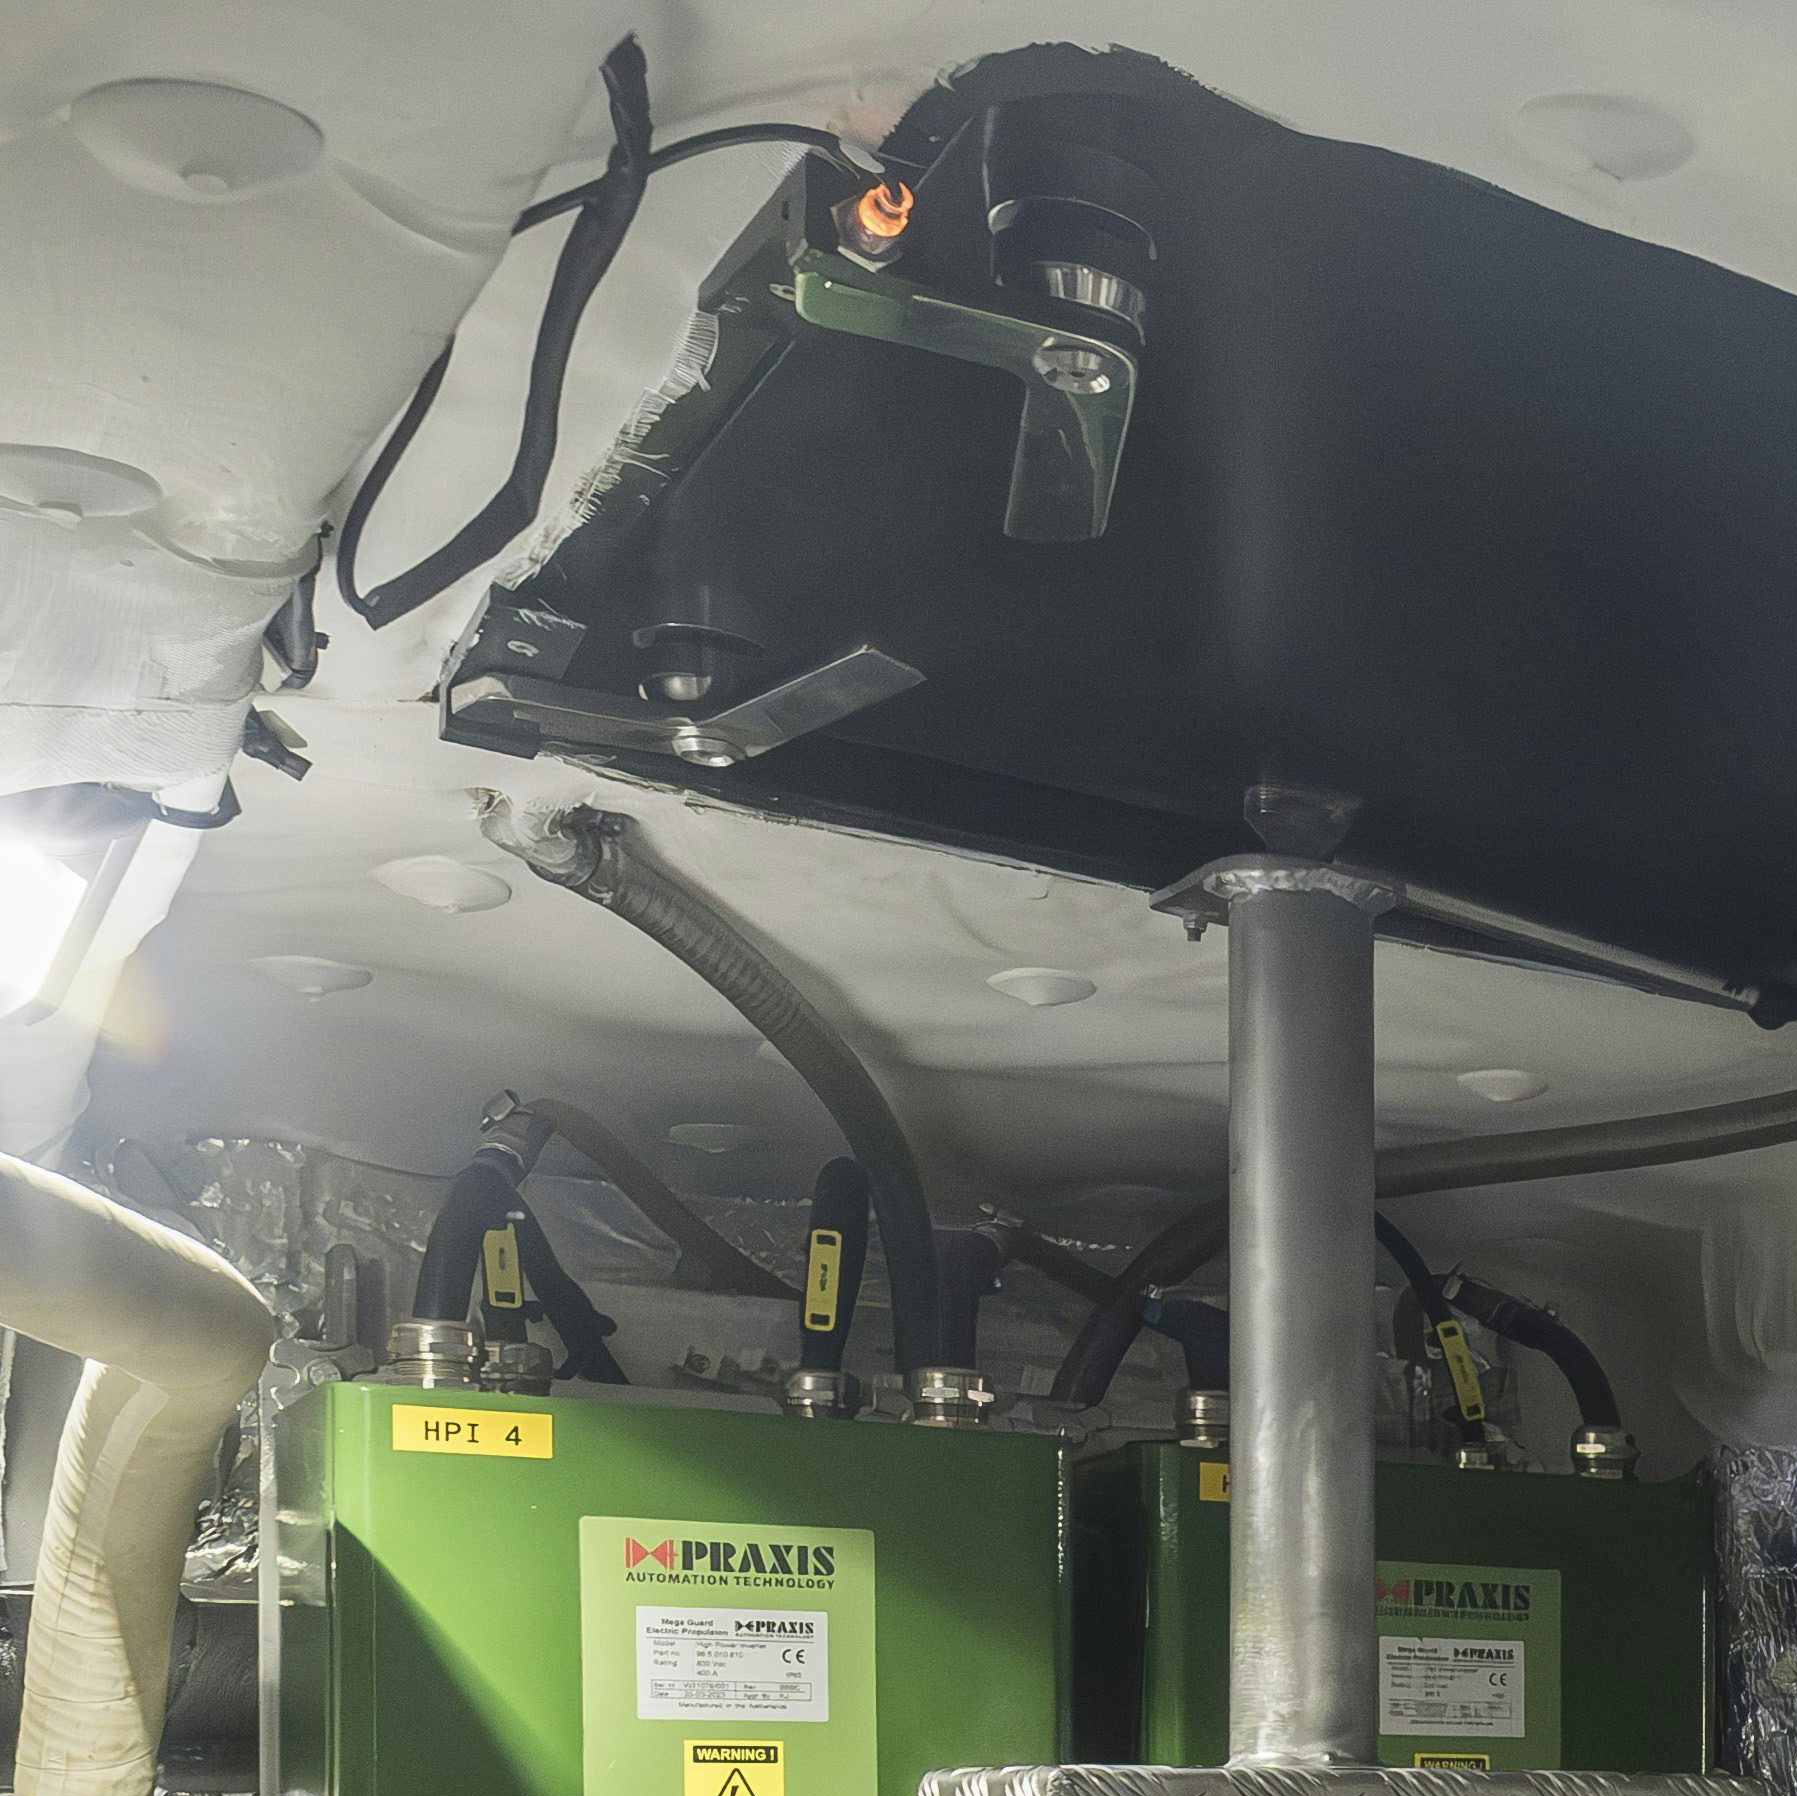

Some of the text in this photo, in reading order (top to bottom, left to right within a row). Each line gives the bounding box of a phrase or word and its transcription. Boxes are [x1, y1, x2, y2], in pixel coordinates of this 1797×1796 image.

[423, 1421, 522, 1447] HPI 4
[681, 1539, 836, 1577] PRAXIS
[625, 1571, 836, 1590] AUTOMATION TECHNOLOGY
[1414, 1580, 1530, 1610] PRAXIS
[661, 1618, 684, 1627] Mega
[756, 1621, 814, 1633] PRAXIS
[646, 1627, 679, 1635] Electric
[1470, 1648, 1514, 1660] PRAXIS
[696, 1747, 766, 1761] WARNING
[1423, 1760, 1475, 1769] WARNING
